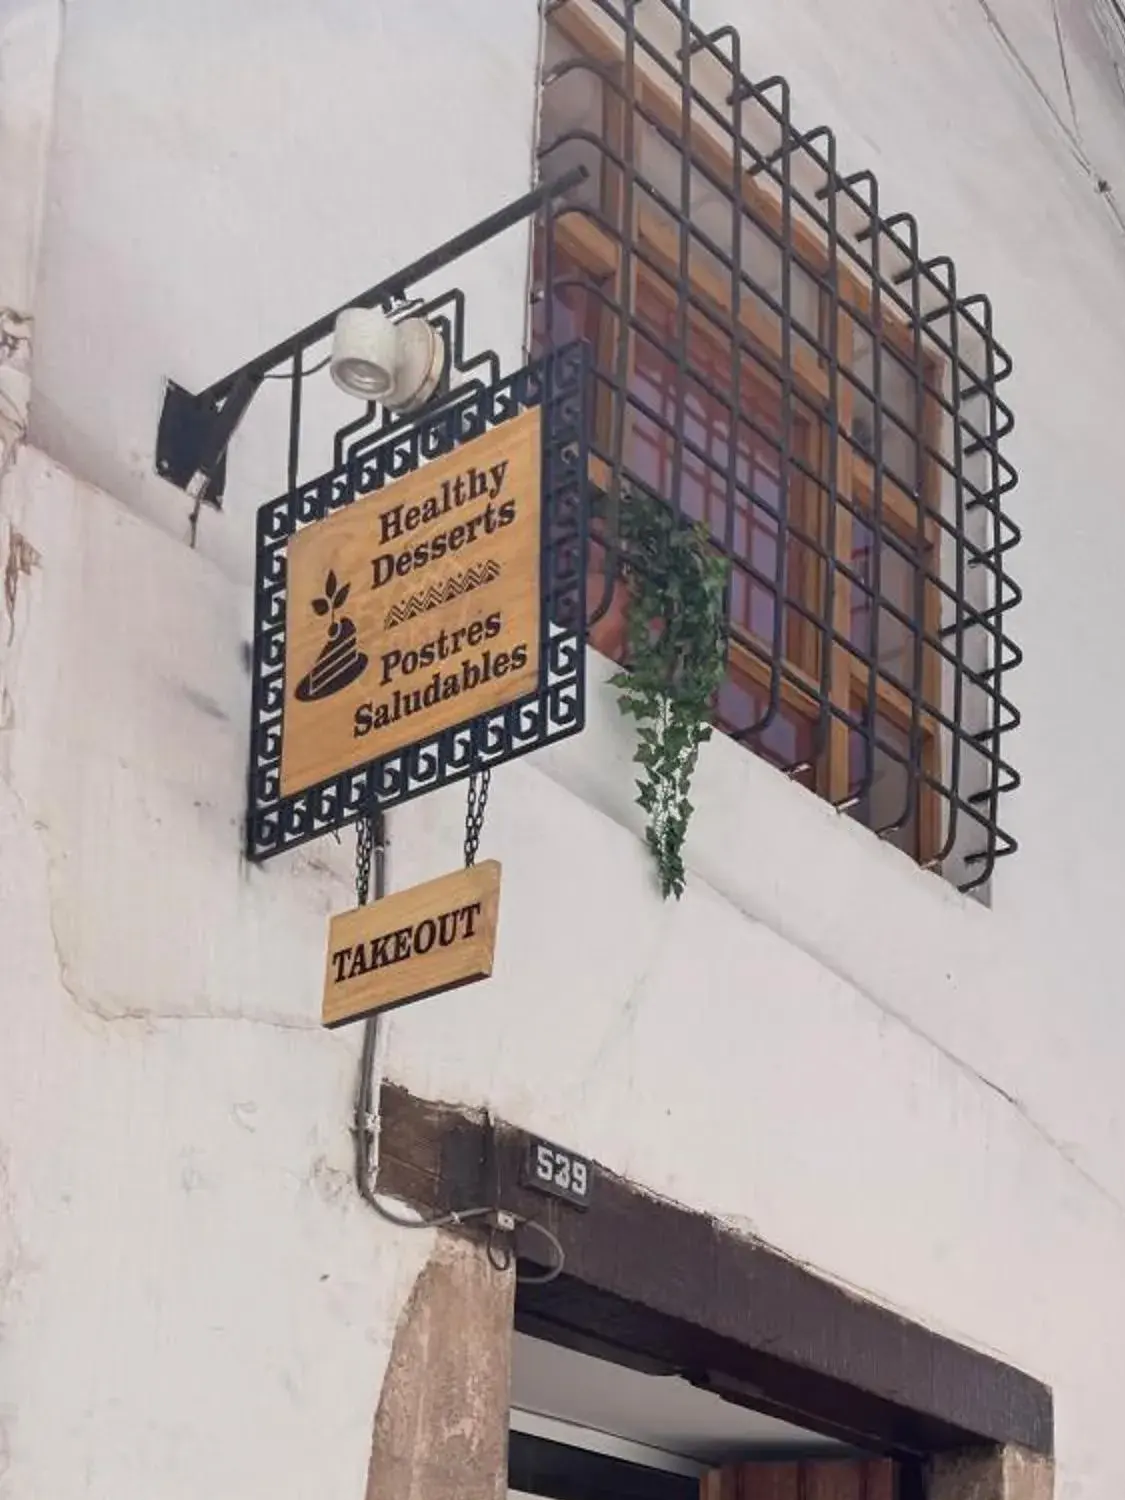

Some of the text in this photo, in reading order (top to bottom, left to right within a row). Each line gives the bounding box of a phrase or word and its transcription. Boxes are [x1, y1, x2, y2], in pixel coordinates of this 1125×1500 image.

[378, 459, 510, 545] Healthy
[370, 498, 516, 590] Desserts
[352, 639, 529, 738] Saludables
[378, 611, 502, 686] Postres
[331, 903, 482, 984] TAKEOUT
[536, 1143, 587, 1197] 539
